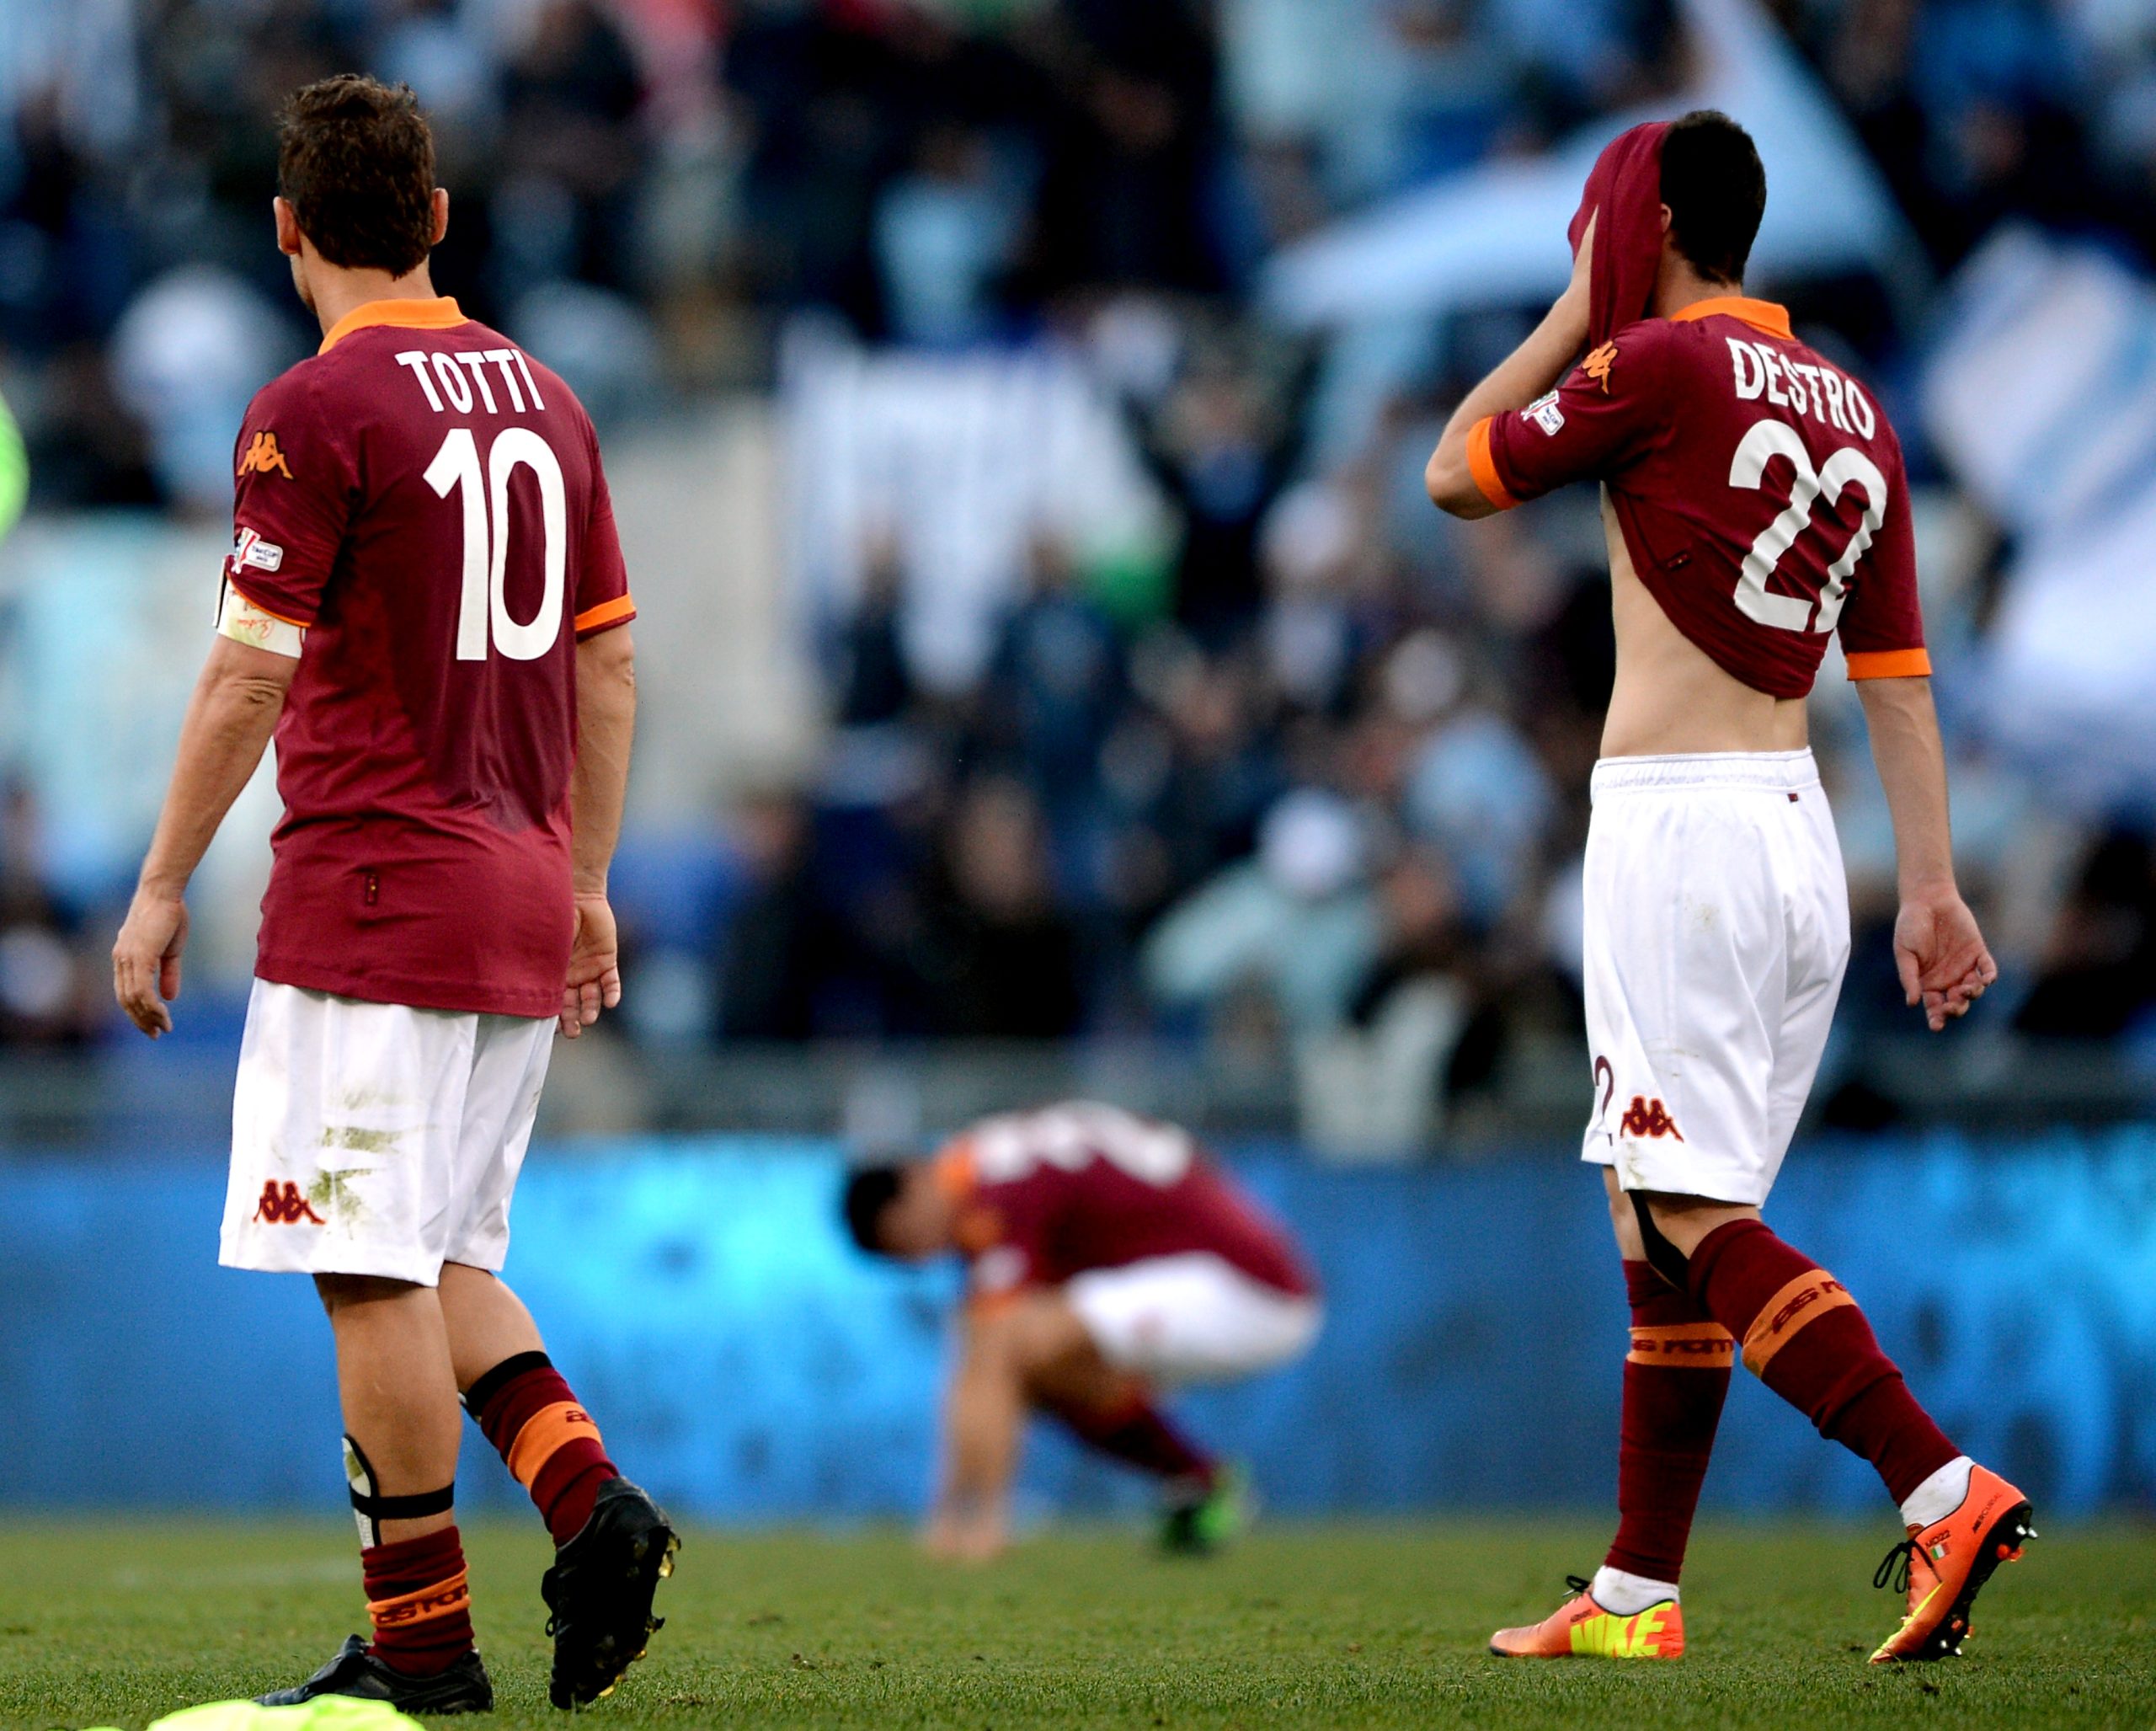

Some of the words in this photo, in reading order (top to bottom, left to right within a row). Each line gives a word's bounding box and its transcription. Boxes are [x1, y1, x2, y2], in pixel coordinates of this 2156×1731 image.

[395, 349, 545, 414] TOTTI
[1726, 337, 1875, 440] DESTRO
[423, 427, 566, 660] 10
[1728, 419, 1887, 633] 22
[1570, 1601, 1674, 1658] NIKE
